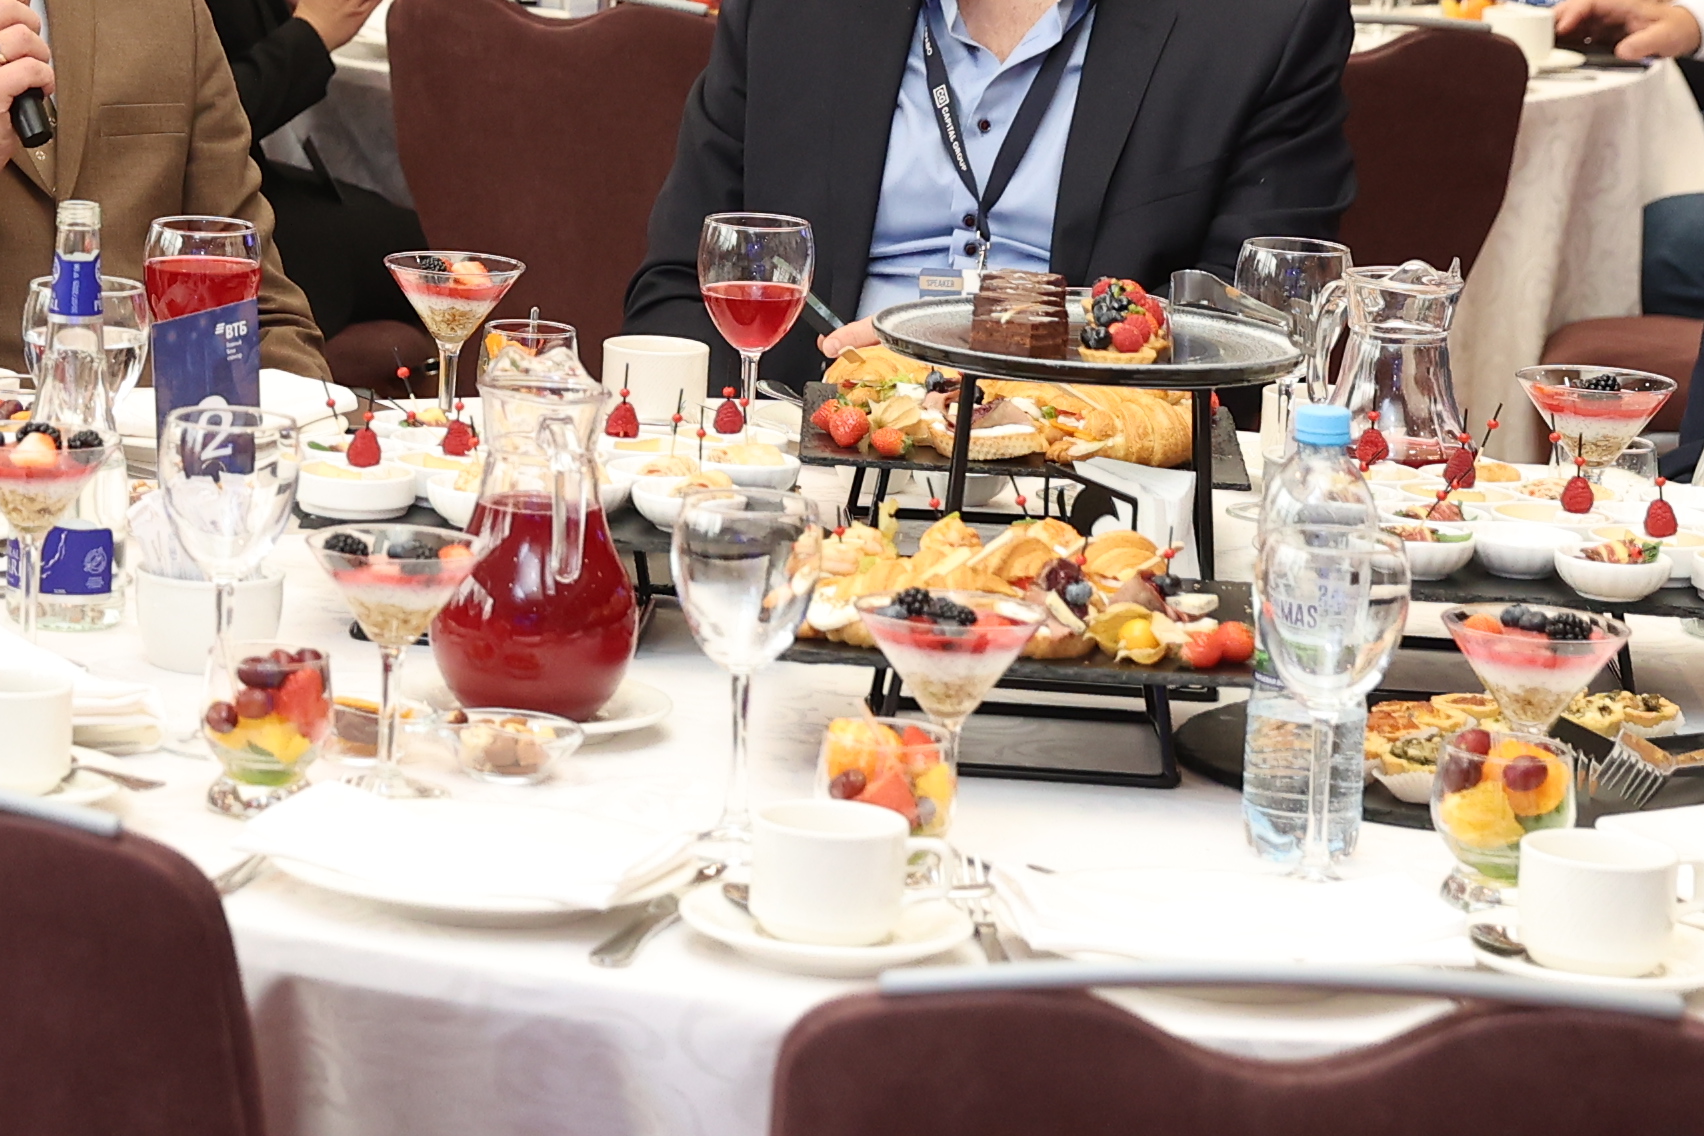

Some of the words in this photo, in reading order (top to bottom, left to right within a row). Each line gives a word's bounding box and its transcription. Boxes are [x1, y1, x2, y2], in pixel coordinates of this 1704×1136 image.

[941, 106, 956, 143] CAPITAL
[952, 141, 967, 171] GROUP
[926, 279, 955, 288] SPEAKER
[225, 320, 248, 340] ВТБ
[198, 395, 233, 461] 2
